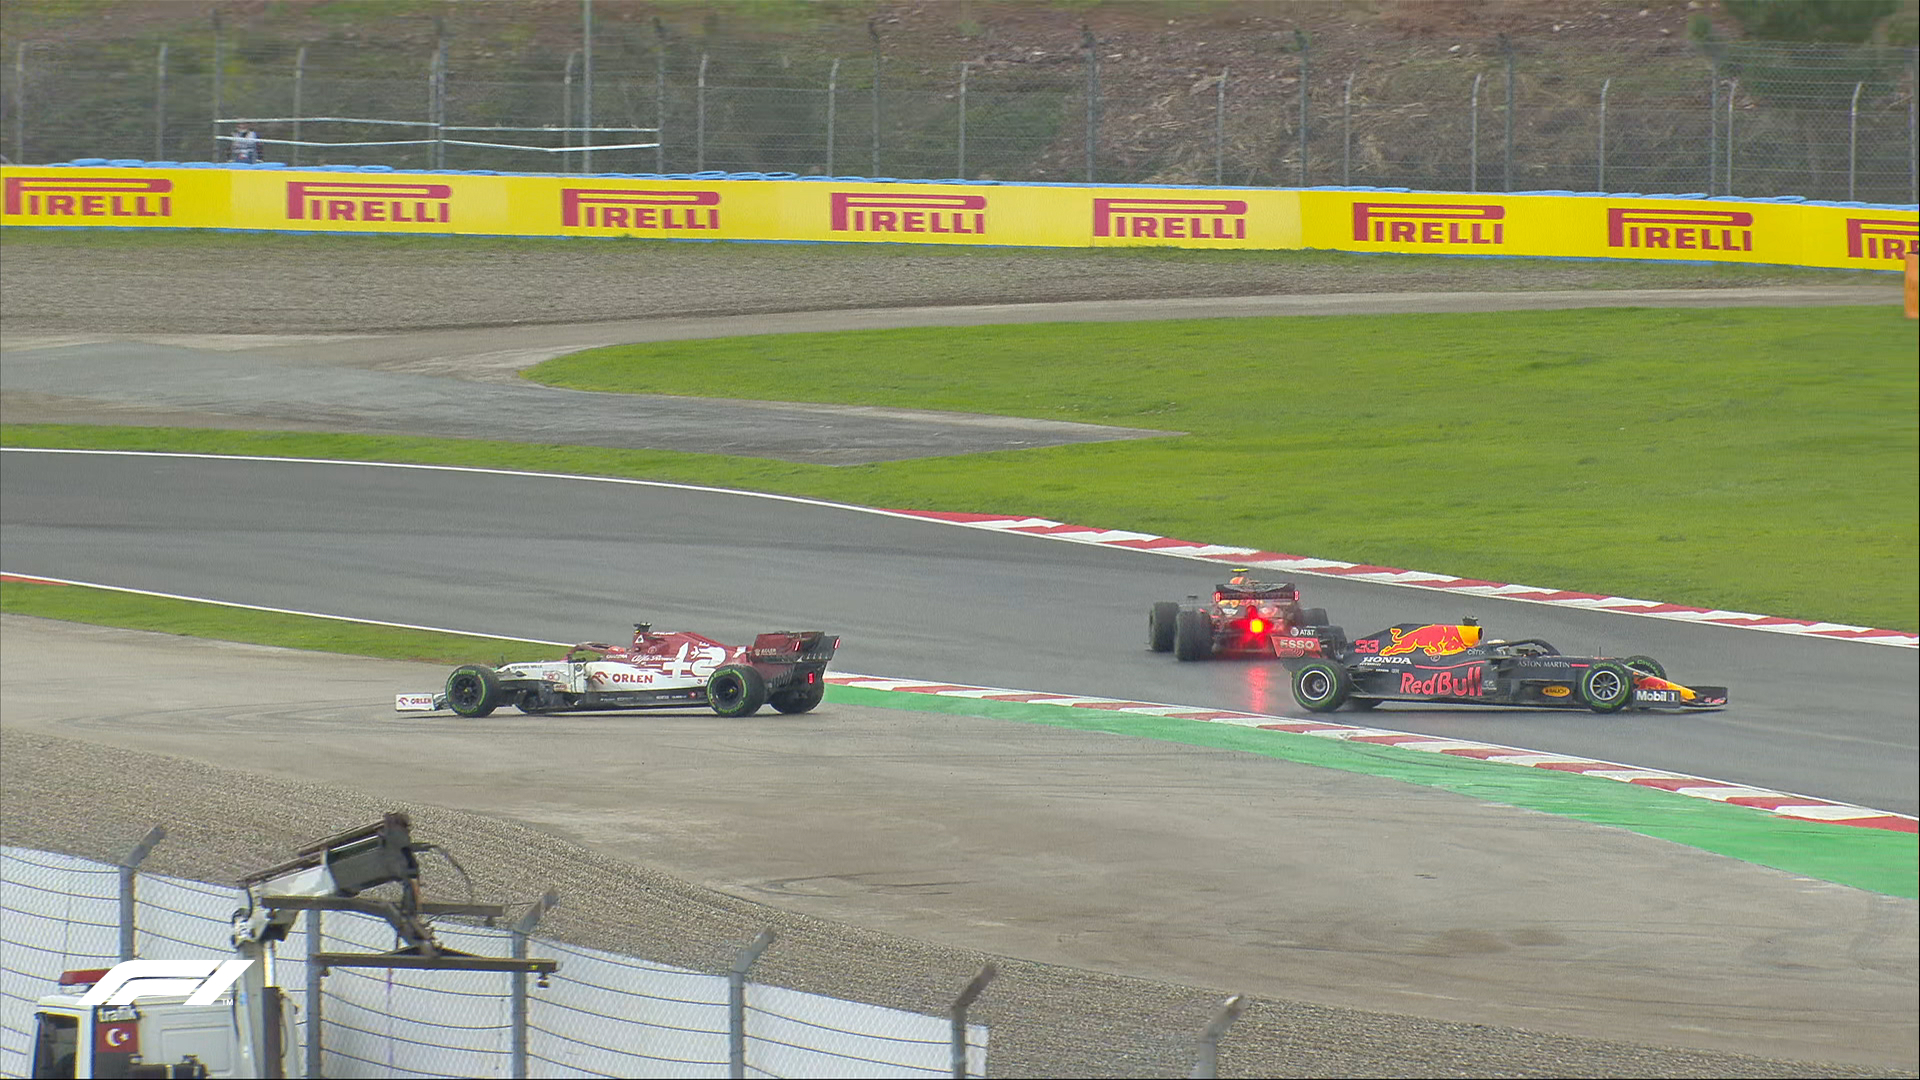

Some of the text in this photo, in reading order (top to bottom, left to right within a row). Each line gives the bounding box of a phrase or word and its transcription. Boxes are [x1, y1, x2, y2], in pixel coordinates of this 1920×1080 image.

[5, 177, 172, 217] PIRELLI
[287, 182, 452, 224] PIRELLI
[561, 189, 720, 230] PIRELLI
[831, 193, 986, 235] PIRELLI
[1094, 199, 1249, 240] PIRELLI
[1352, 202, 1507, 245] PIRELLI
[1607, 208, 1755, 252] PIRELLI
[1279, 640, 1315, 649] ESSO
[1354, 639, 1379, 653] 33
[1361, 656, 1412, 665] HONDA
[612, 673, 653, 684] ORLEN
[1636, 690, 1668, 702] Mobil
[410, 697, 432, 705] ORLEN
